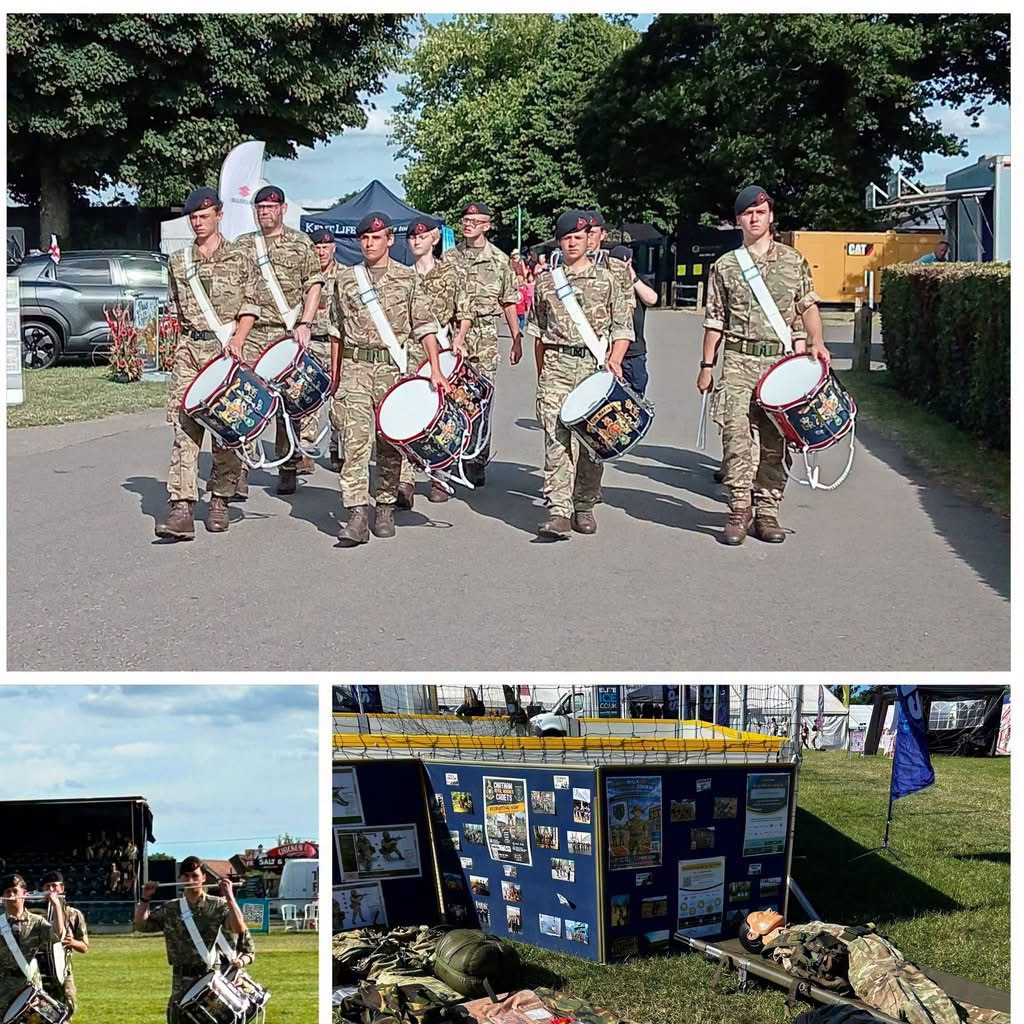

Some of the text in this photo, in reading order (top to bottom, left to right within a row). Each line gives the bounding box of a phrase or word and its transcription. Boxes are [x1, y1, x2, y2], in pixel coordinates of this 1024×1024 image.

[305, 222, 357, 235] KET LIFE
[848, 244, 867, 256] CAT
[599, 693, 617, 702] ICE
